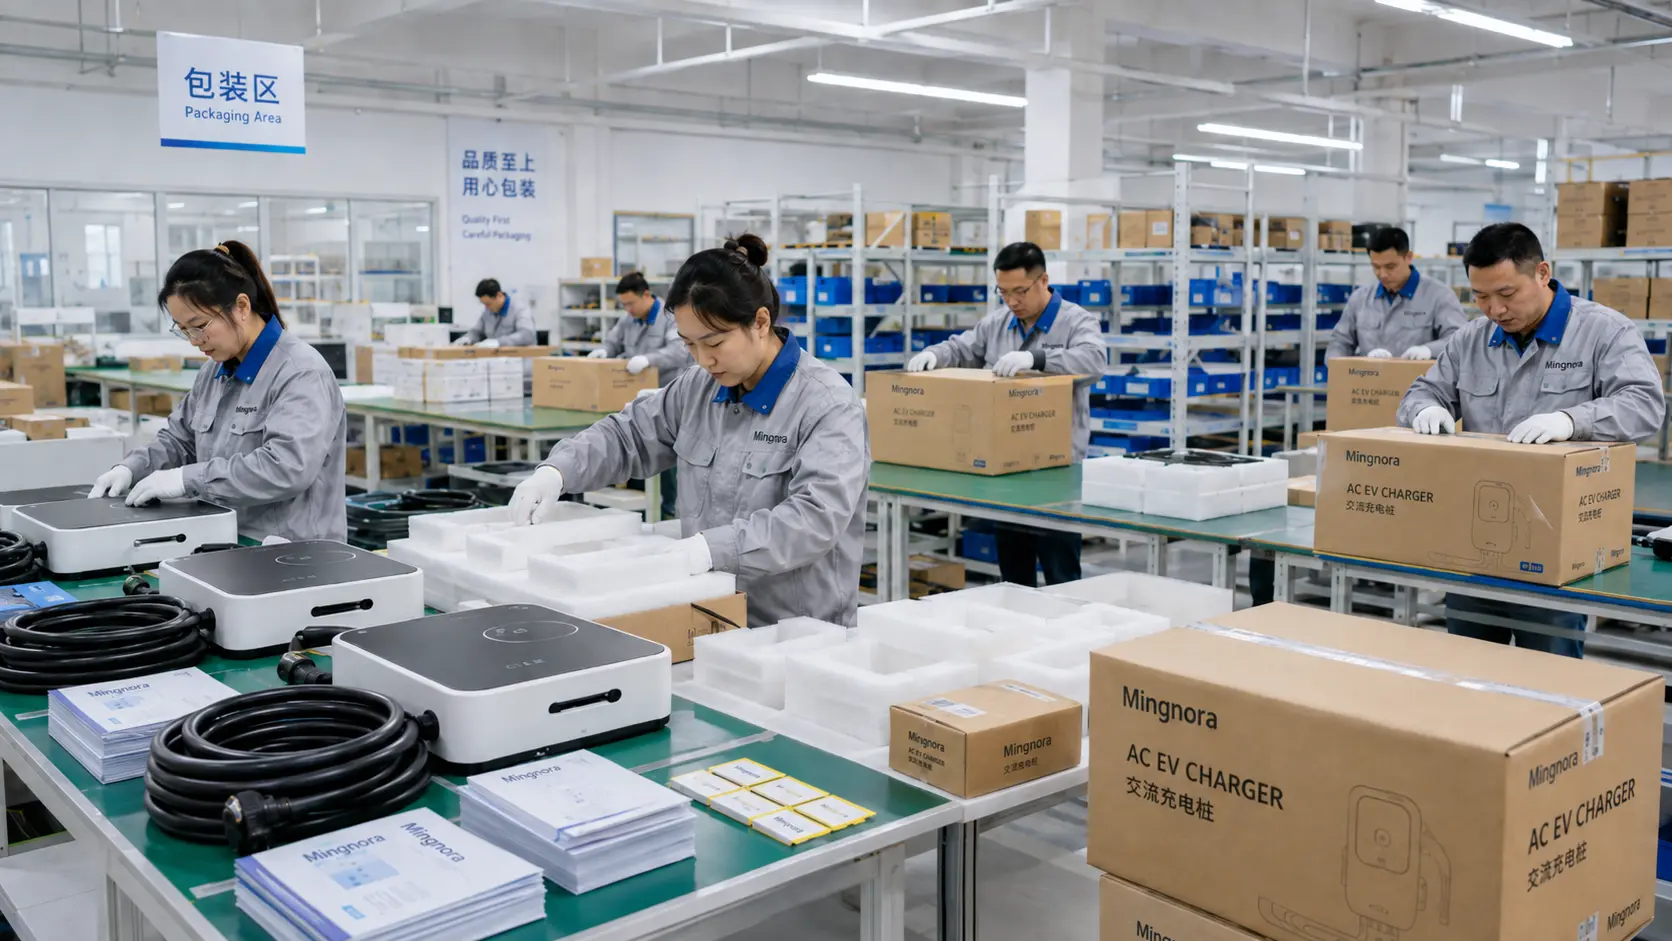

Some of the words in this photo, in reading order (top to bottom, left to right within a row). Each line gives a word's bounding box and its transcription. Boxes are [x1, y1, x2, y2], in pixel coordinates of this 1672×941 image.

[184, 67, 279, 104] 包装区
[185, 106, 249, 124] Packaging
[254, 111, 282, 123] Area
[462, 150, 535, 172] 品质至上
[462, 177, 535, 198] 用心包装
[462, 215, 490, 225] Quality
[493, 215, 510, 224] First
[462, 230, 490, 239] Careful
[493, 230, 531, 241] Packaging
[891, 384, 924, 396] Mingnora
[1346, 450, 1400, 467] Mingnora
[1347, 483, 1362, 495] AC
[1364, 485, 1379, 496] EV
[1381, 487, 1434, 503] CHARGER
[1579, 493, 1587, 507] AC
[1588, 493, 1596, 504] EV
[1596, 488, 1621, 503] CHARGER
[1345, 500, 1396, 516] 交流充电桩
[1122, 685, 1218, 730] Mingnora
[908, 730, 945, 753] Mingnora
[1003, 736, 1052, 758] Mingnora
[501, 764, 562, 783] Mingnora
[1126, 743, 1151, 767] AC
[1157, 751, 1180, 776] EV
[1185, 761, 1284, 811] CHARGER
[1528, 751, 1579, 790] Mingnora
[1126, 775, 1215, 823] 交流充电桩
[1528, 822, 1549, 855] AC
[1553, 810, 1572, 841] EV
[1576, 777, 1636, 828] CHARGER
[303, 834, 386, 863] Mingnora
[401, 822, 465, 863] Mingnora
[1527, 841, 1588, 893] 交流充电桩
[1607, 898, 1641, 933] Mingnora
